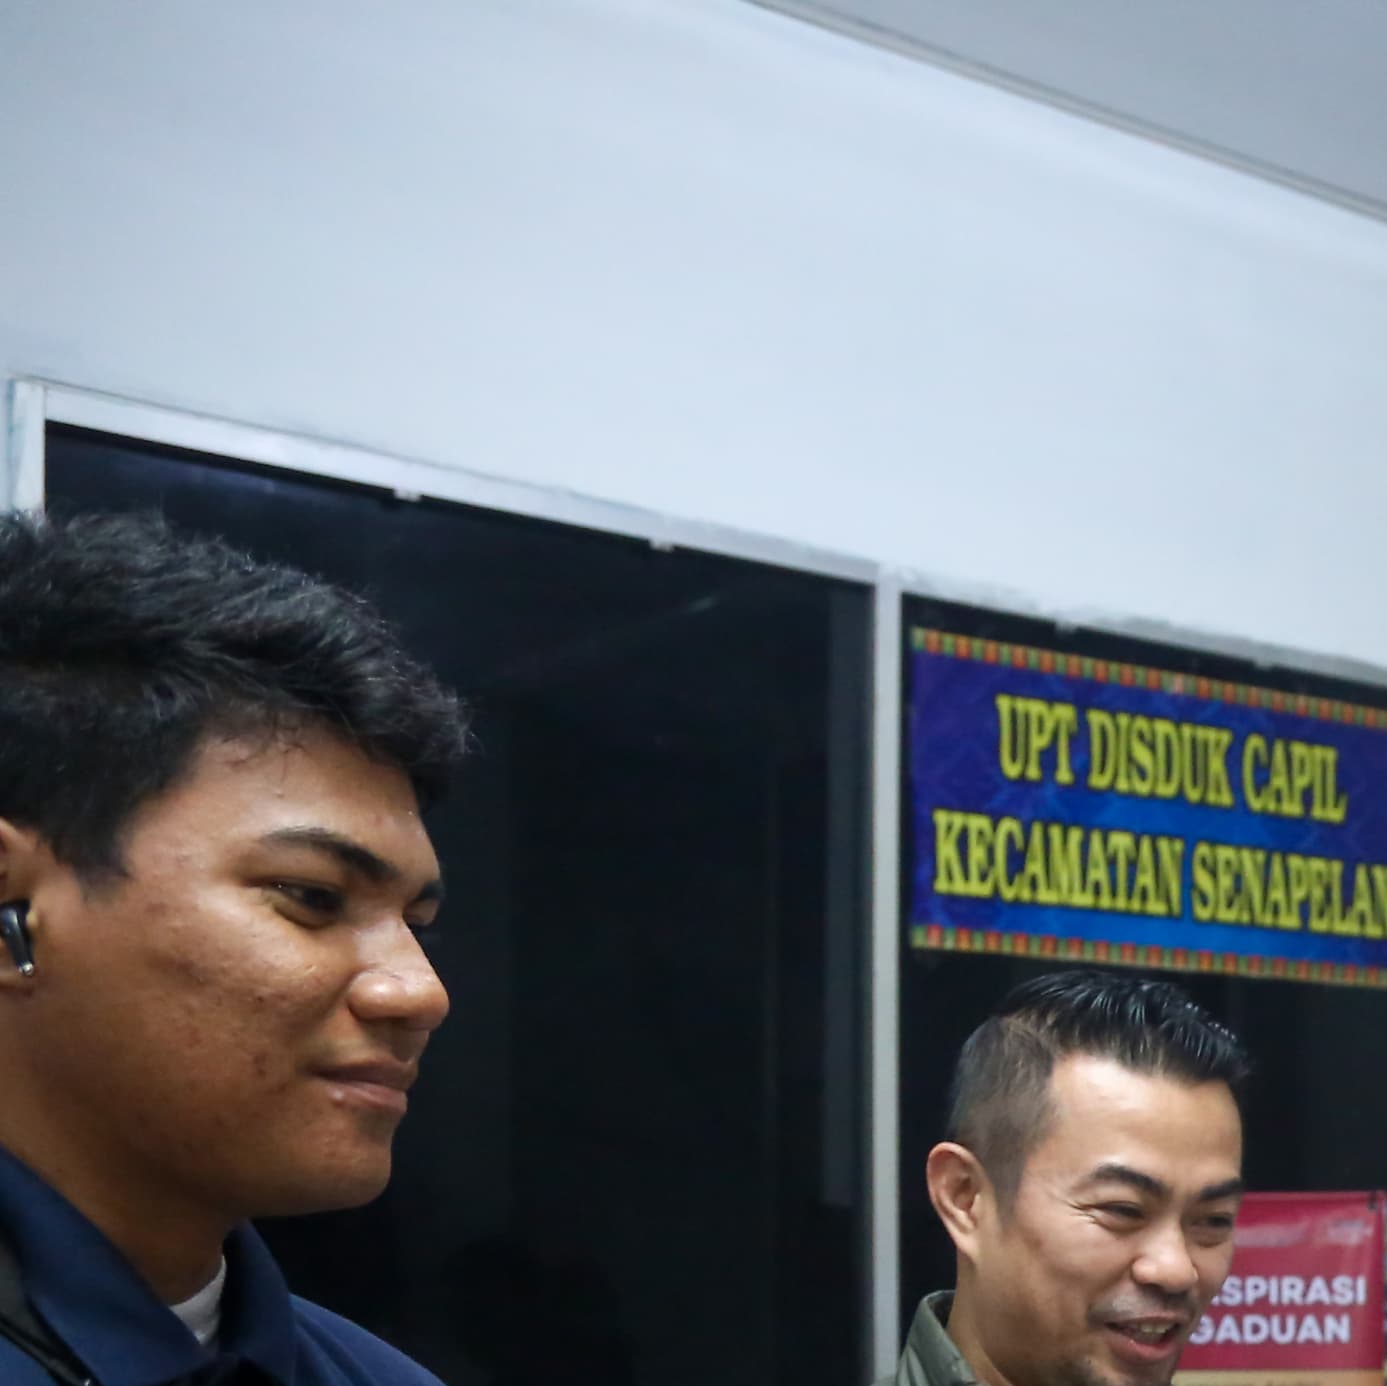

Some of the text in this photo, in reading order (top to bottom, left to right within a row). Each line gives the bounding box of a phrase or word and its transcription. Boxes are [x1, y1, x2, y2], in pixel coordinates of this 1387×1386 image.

[996, 694, 1348, 823] UPT DISDUK CAPIL
[933, 809, 1184, 916] KECAMATAN
[1213, 1276, 1366, 1306] SPIRASI
